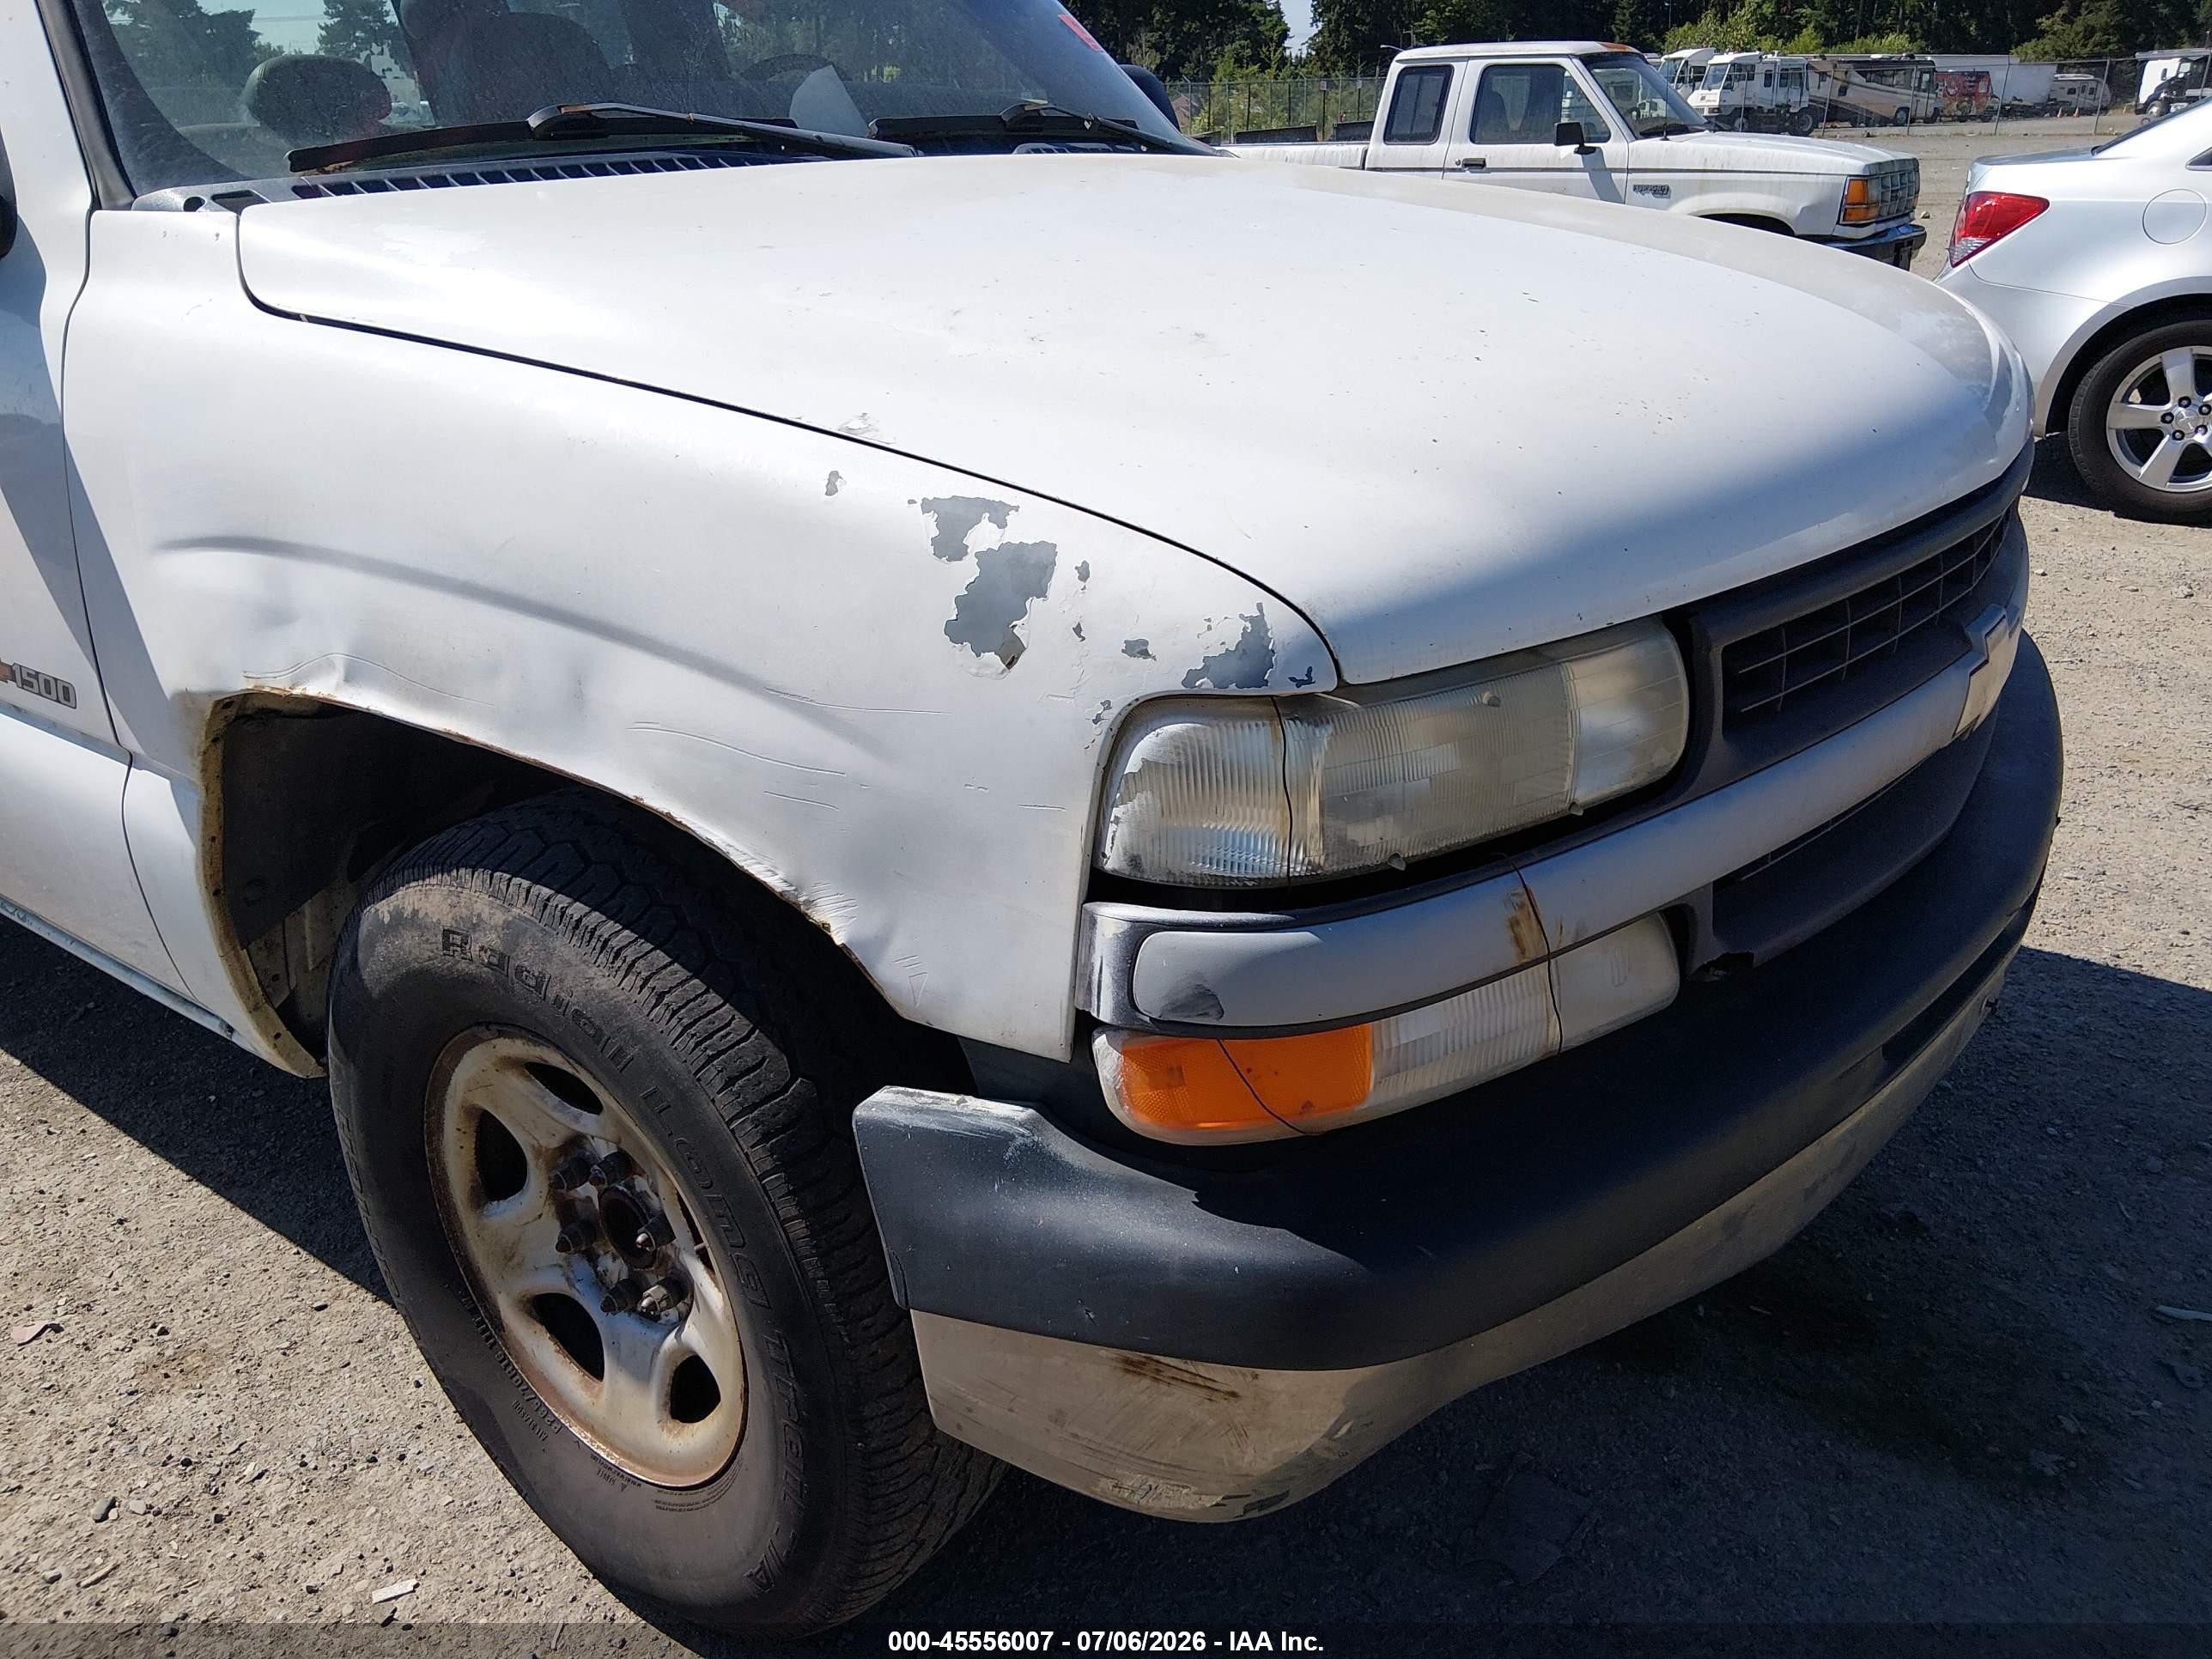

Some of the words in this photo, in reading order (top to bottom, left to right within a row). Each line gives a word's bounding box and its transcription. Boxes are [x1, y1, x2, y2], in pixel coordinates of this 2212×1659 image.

[12, 663, 76, 708] 1500
[442, 927, 639, 1073] Radial
[640, 1085, 771, 1309] Long
